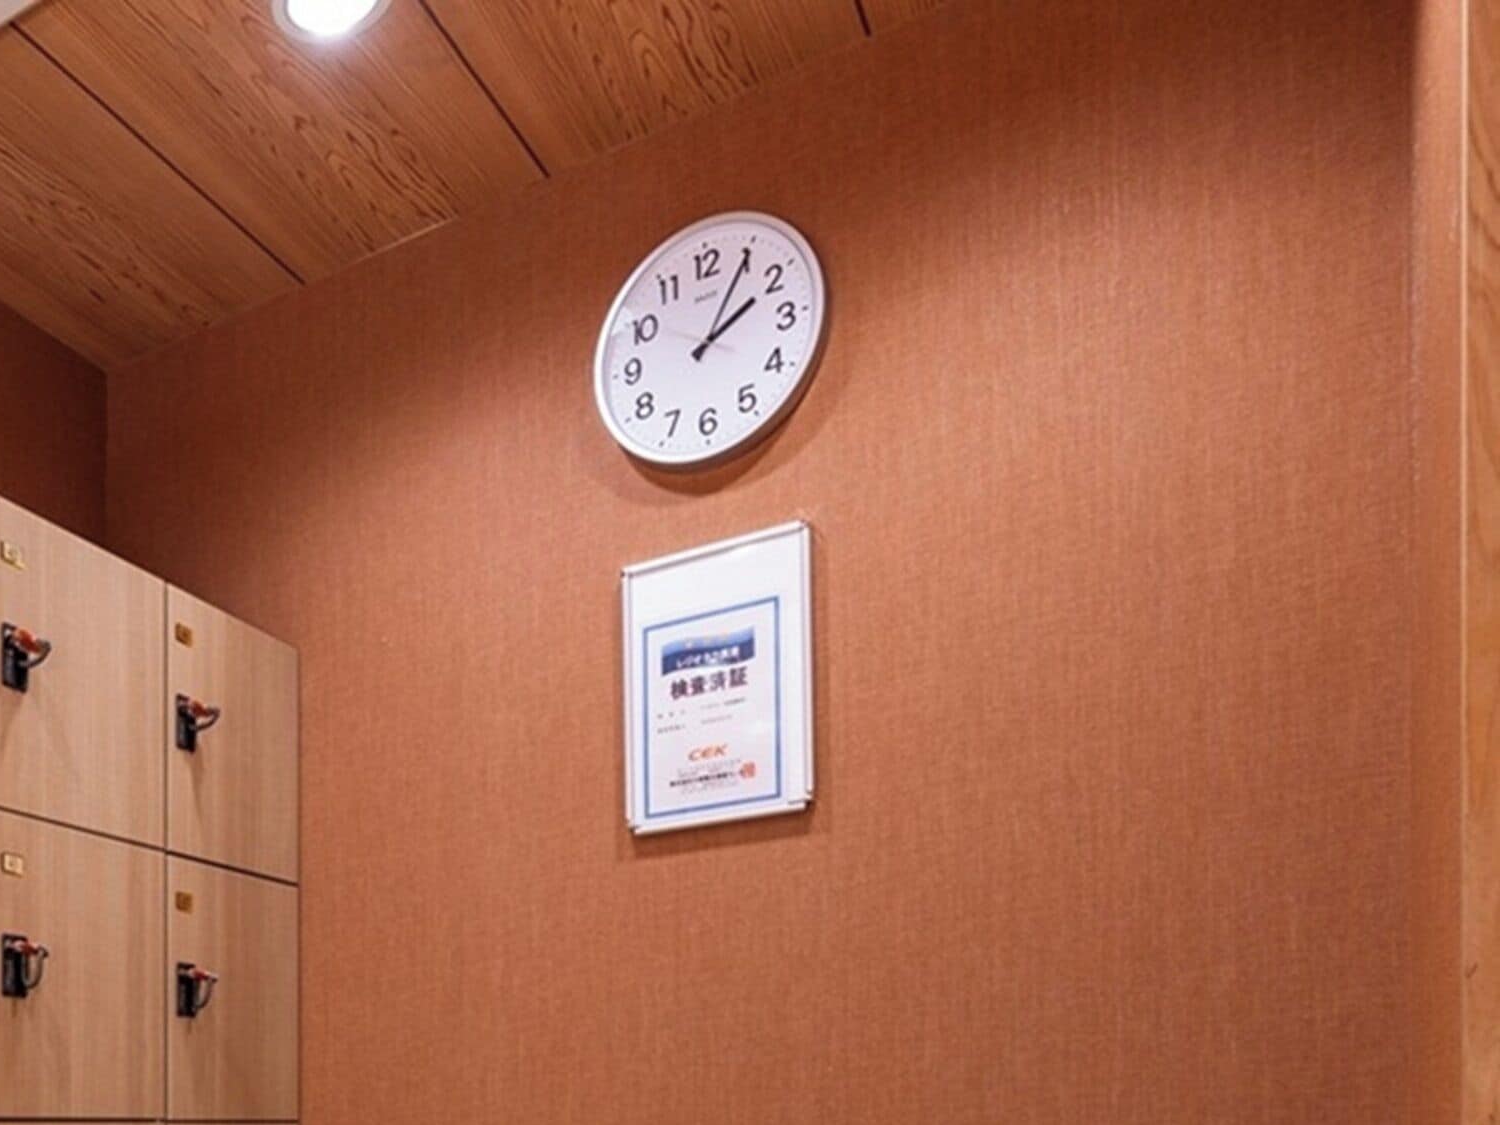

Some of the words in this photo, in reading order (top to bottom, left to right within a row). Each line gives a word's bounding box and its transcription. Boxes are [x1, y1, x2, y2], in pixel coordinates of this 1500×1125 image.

[693, 247, 721, 281] 12
[764, 263, 785, 295] 2
[659, 275, 680, 305] 11
[632, 313, 659, 346] 10
[775, 301, 797, 332] 3
[623, 357, 643, 386] 9
[763, 347, 784, 375] 4
[635, 391, 655, 421] 8
[737, 384, 757, 414] 5
[664, 409, 682, 438] 7
[698, 407, 718, 436] 6
